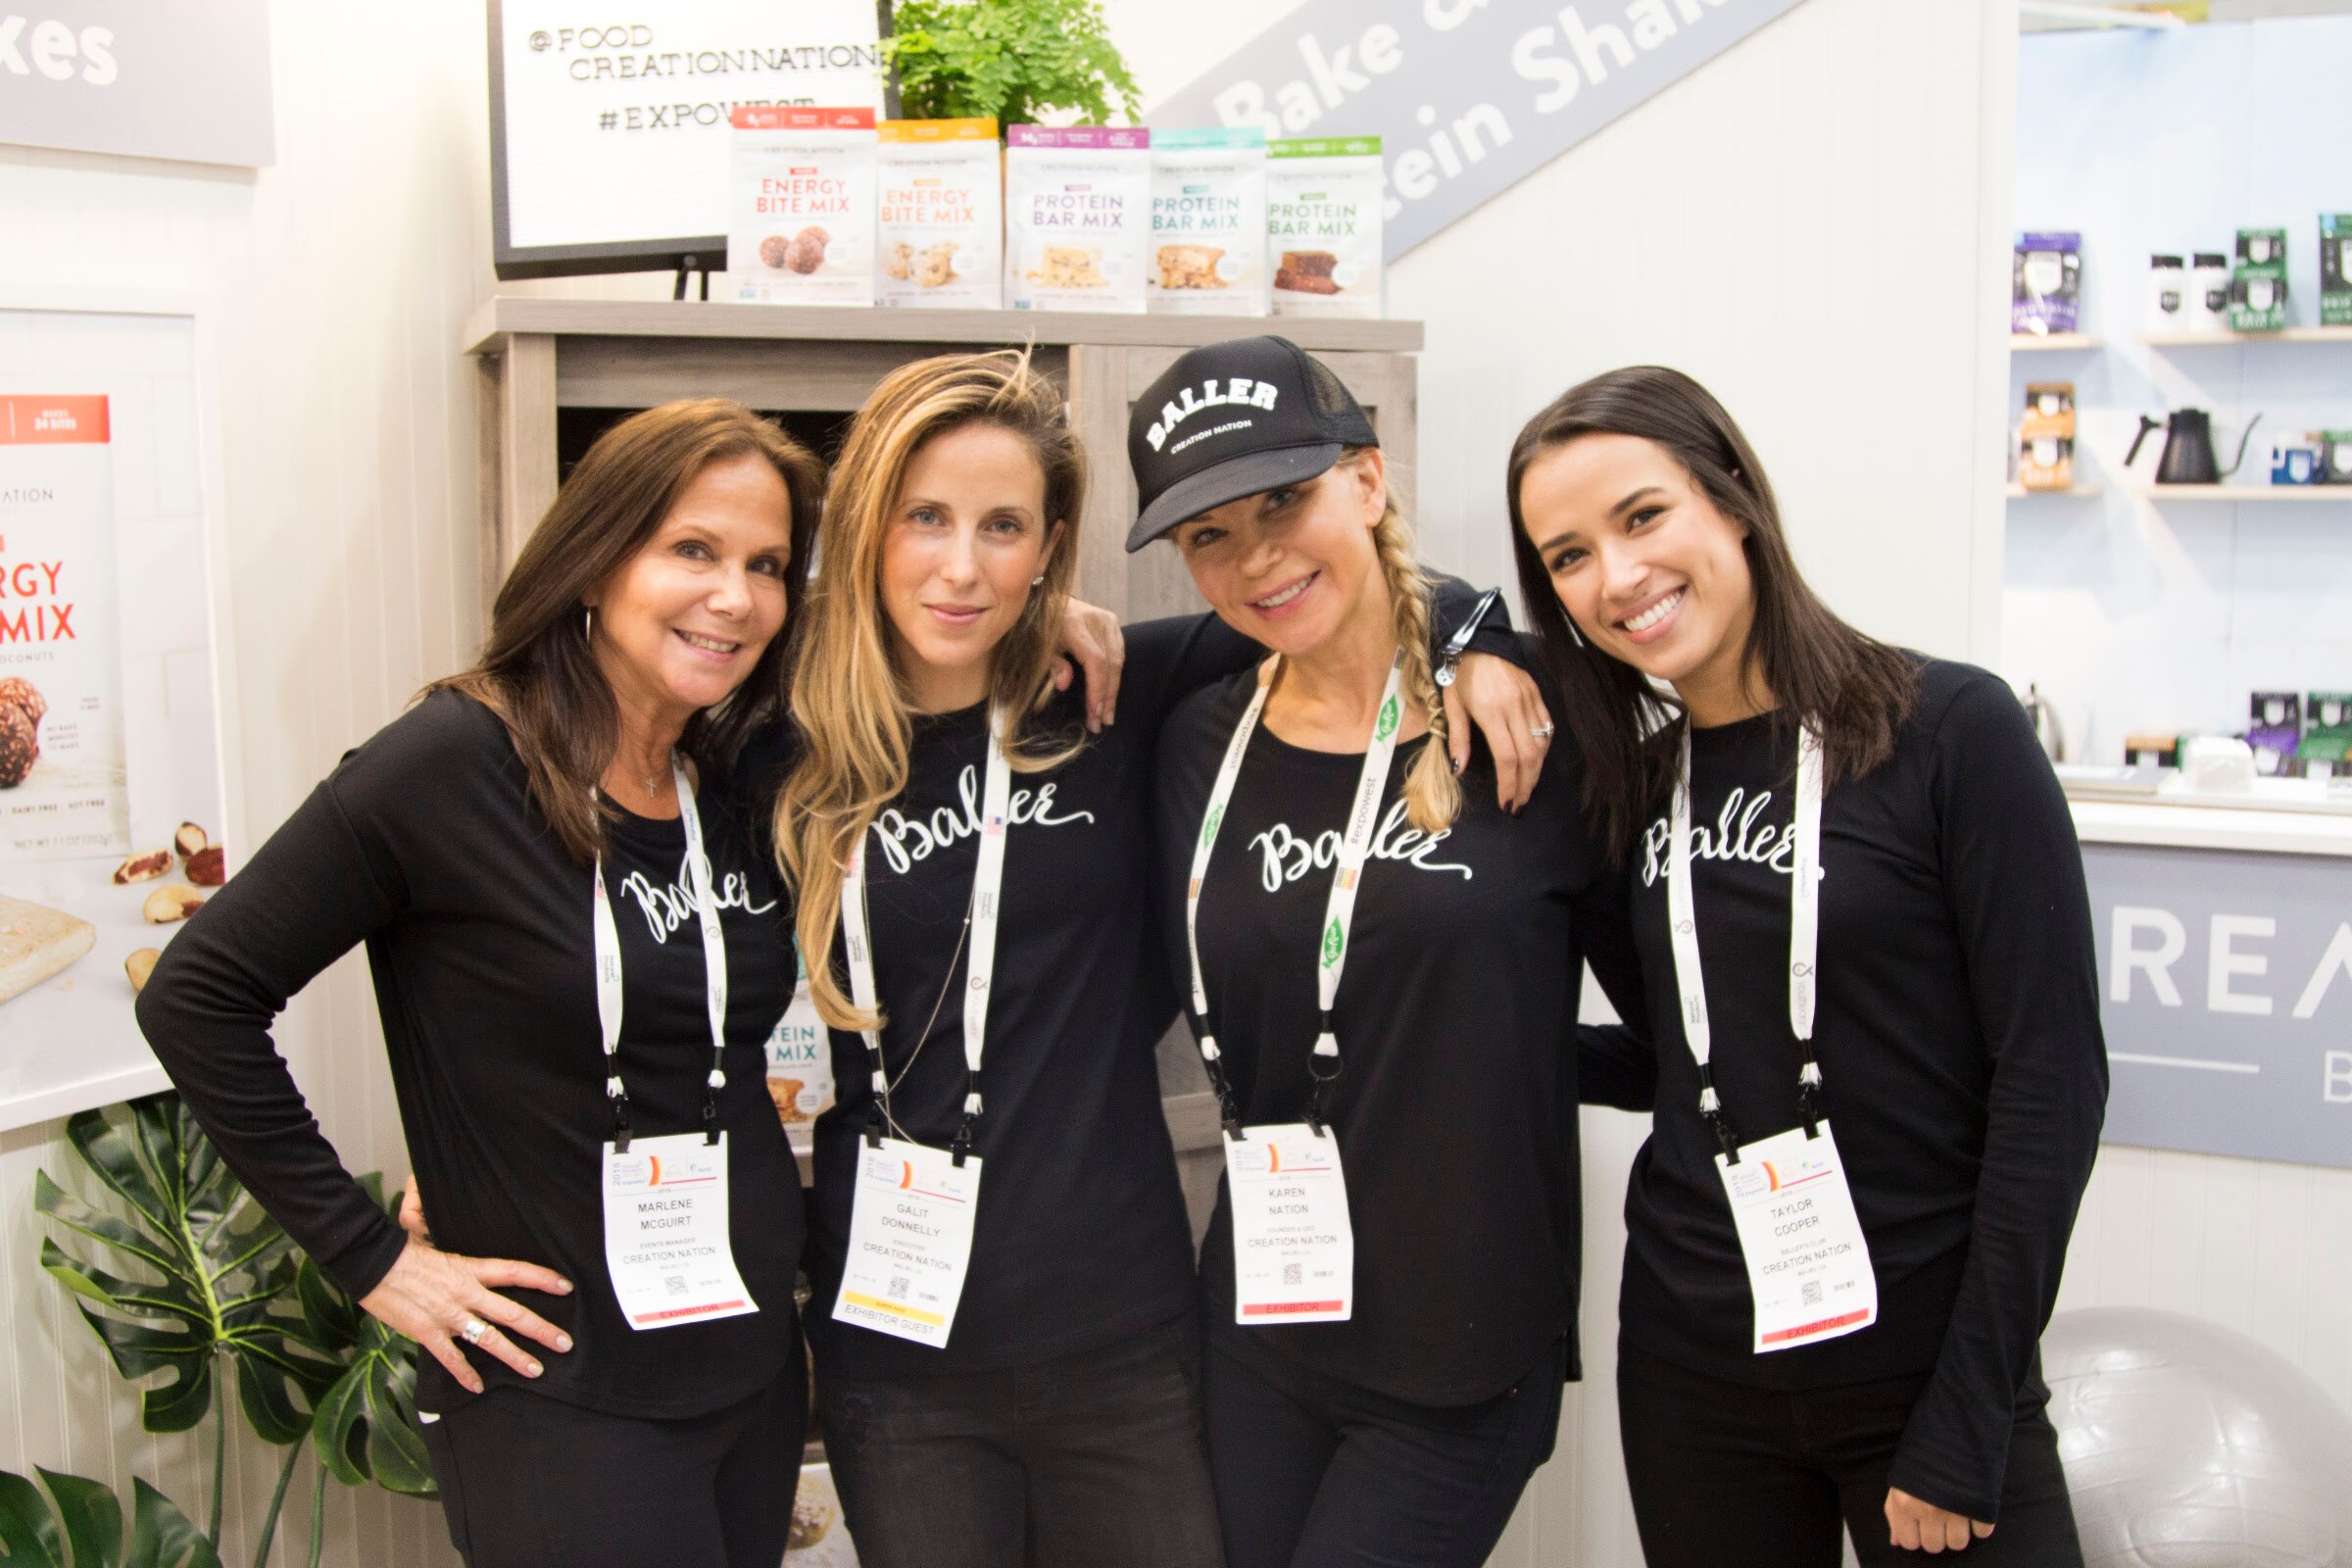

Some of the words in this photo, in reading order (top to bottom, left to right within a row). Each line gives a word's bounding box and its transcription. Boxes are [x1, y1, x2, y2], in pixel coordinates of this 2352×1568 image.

[529, 24, 653, 52] @FOOD
[1213, 24, 1404, 139] Bake
[762, 178, 845, 194] ENERGY
[886, 190, 969, 205] ENERGY
[1034, 195, 1123, 212] PROTEIN
[1152, 197, 1239, 212] PROTEIN
[757, 198, 801, 214] BITE
[809, 198, 850, 213] MIX
[1269, 204, 1356, 219] PROTEIN
[881, 207, 924, 223] BITE
[934, 207, 974, 222] MIX
[1034, 212, 1073, 226] BAR
[1083, 213, 1123, 228] MIX
[1152, 215, 1194, 230] BAR
[1200, 214, 1239, 229] MIX
[1268, 221, 1311, 236] BAR
[1317, 221, 1356, 236] MIX
[1147, 378, 1278, 452] BALLER
[1171, 429, 1212, 454] CREATION
[1213, 419, 1252, 435] NATION
[0, 604, 75, 643] MIX
[868, 764, 1096, 874] Baler
[1349, 777, 1377, 845] #expowest
[775, 1045, 815, 1062] MIX
[1268, 1188, 1305, 1199] KAREN
[638, 1199, 693, 1213] MARLENE
[897, 1203, 928, 1218] GALIT
[1269, 1204, 1308, 1215] NATION
[1771, 1199, 1814, 1219] TAYLOR
[641, 1216, 692, 1230] MCGUIRT
[881, 1216, 941, 1238] DONNELLY
[1774, 1215, 1820, 1237] COOPER
[1249, 1237, 1298, 1248] CREATION
[1300, 1235, 1338, 1245] NATION
[623, 1251, 675, 1265] CREATION
[678, 1247, 715, 1258] NATION
[862, 1242, 913, 1262] CREATION
[915, 1255, 953, 1271] NATION
[1762, 1254, 1812, 1274] CREATION
[1815, 1242, 1851, 1259] NATION
[660, 1304, 719, 1319] EXHIBITOR
[1266, 1302, 1319, 1313] EXHIBITOR
[845, 1303, 899, 1325] EXHIBITOR
[901, 1319, 936, 1334] GUEST
[1788, 1316, 1844, 1339] EXHIBITOR
